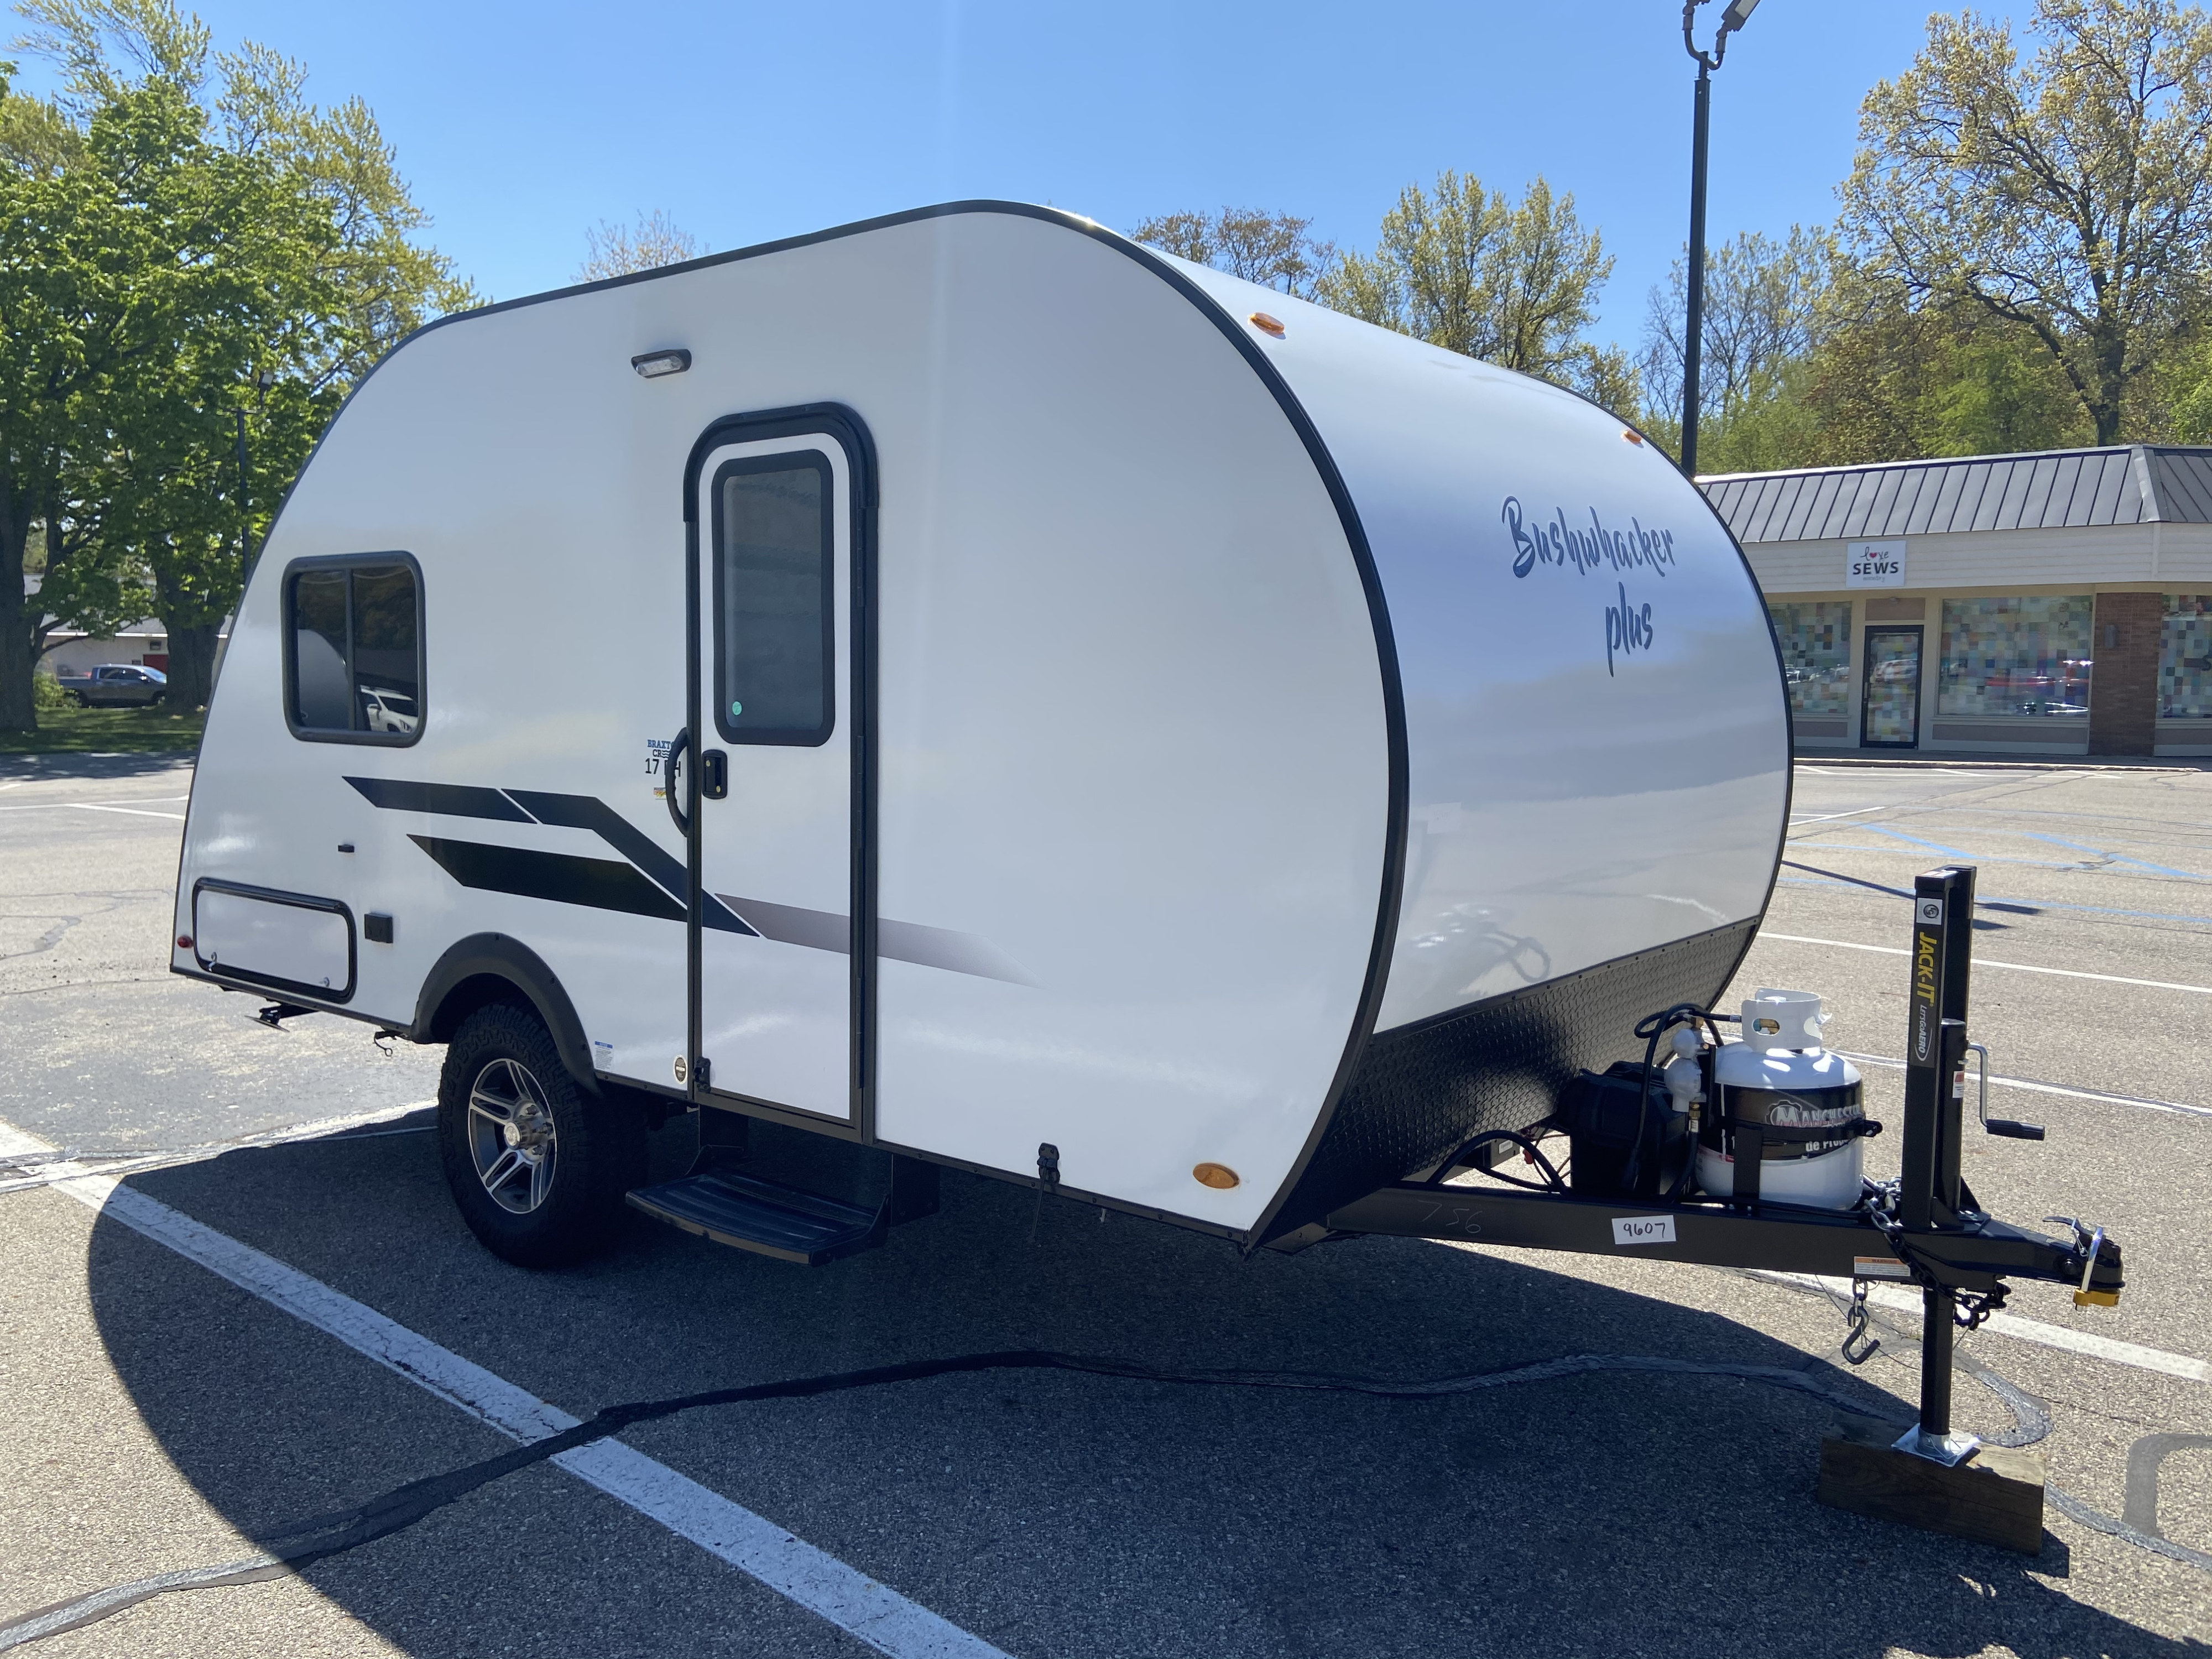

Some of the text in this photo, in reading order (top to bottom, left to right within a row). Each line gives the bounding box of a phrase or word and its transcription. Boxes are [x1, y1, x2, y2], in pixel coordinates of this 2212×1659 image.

[1501, 496, 1675, 578] Bushwhacker
[1853, 562, 1898, 575] SEWS
[1605, 581, 1652, 677] plus
[645, 758, 659, 774] 17
[1917, 931, 1937, 1003] JACK-IT
[1623, 1222, 1666, 1238] 9607
